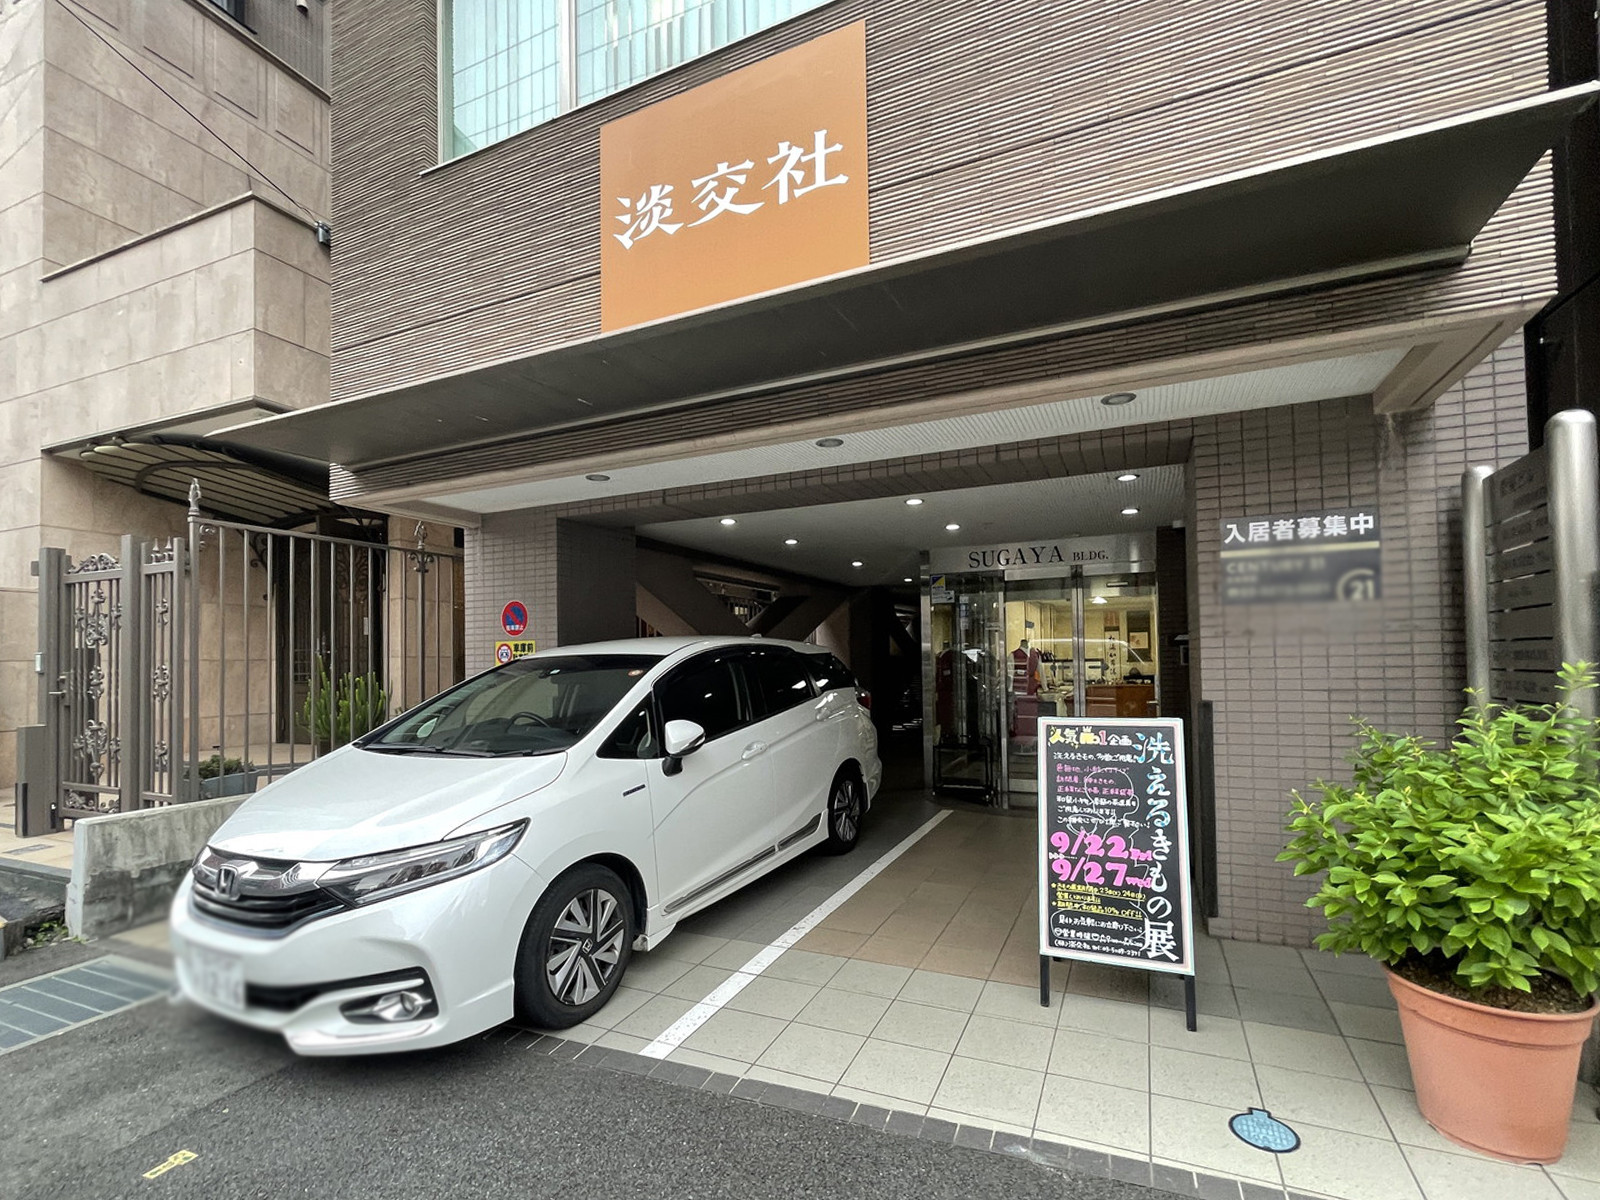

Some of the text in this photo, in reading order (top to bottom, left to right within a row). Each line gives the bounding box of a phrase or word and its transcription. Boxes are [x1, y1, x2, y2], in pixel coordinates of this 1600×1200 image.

[612, 129, 849, 250] 淡交社
[1224, 512, 1375, 544] 入居者募集中
[968, 545, 1109, 569] SUGAYA BLDG.
[1132, 732, 1179, 961] 洗えるきもの展
[1051, 857, 1127, 887] 9/27
